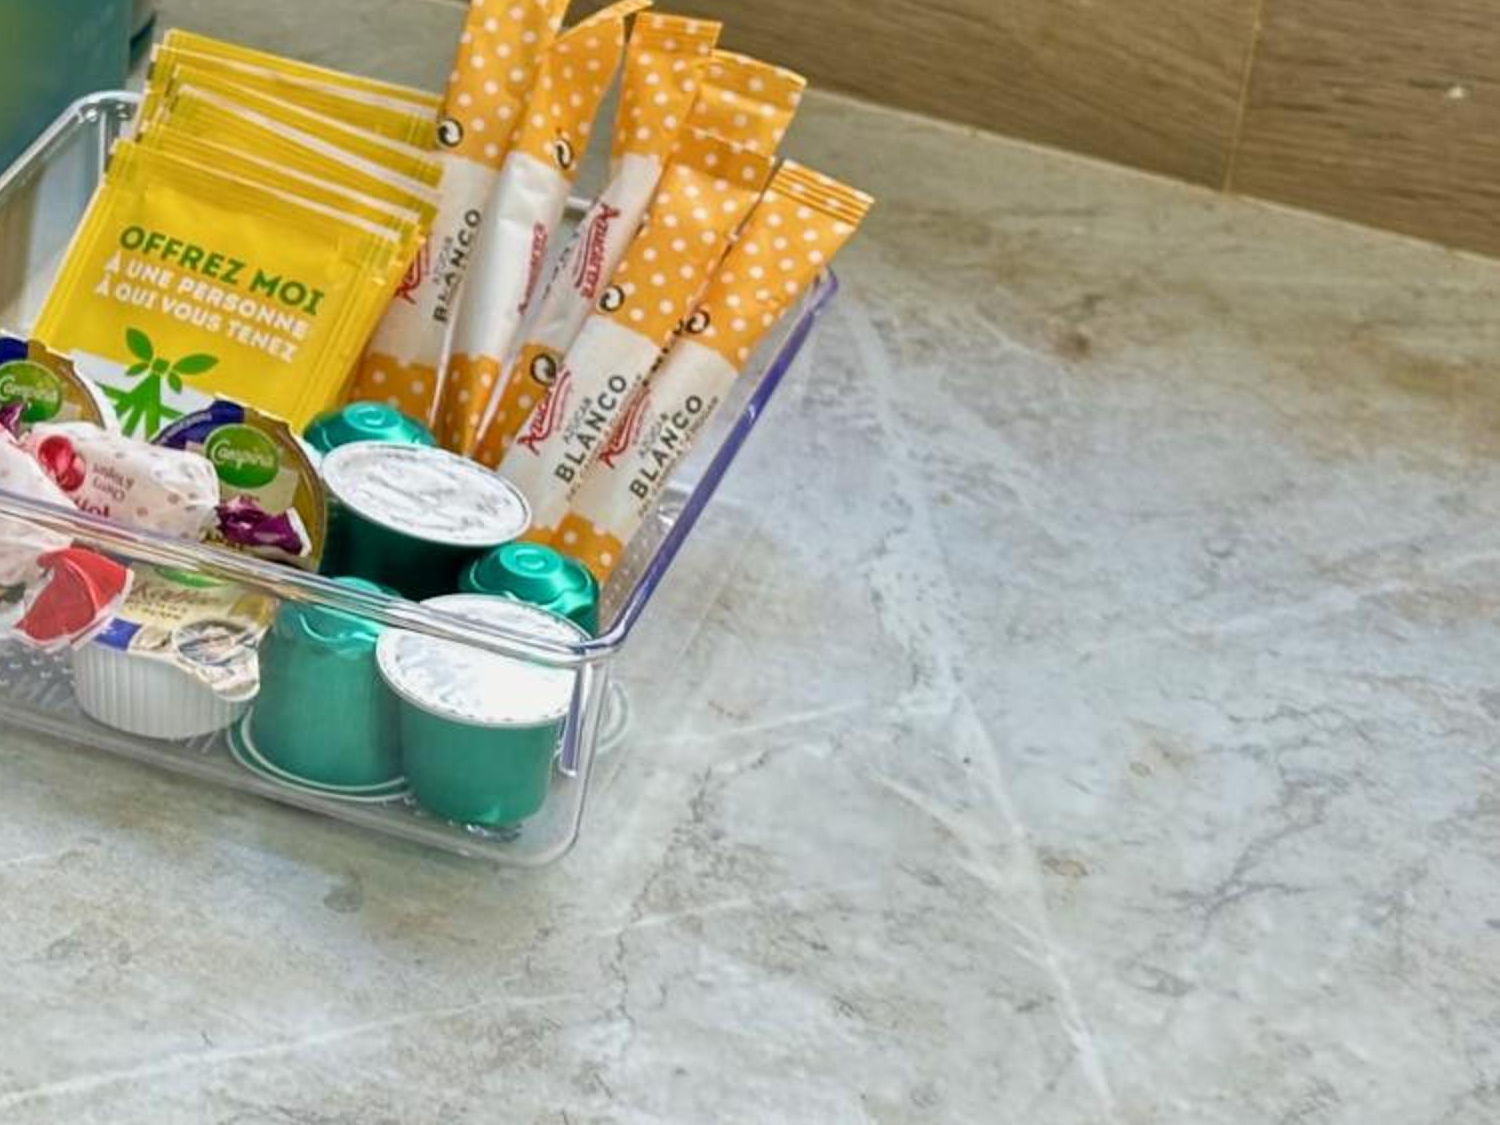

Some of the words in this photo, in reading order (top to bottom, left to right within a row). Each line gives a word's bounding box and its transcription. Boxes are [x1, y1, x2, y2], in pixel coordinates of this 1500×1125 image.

[119, 225, 246, 285] OFFREZ
[249, 268, 325, 316] MOI
[127, 258, 175, 288] UNE
[178, 277, 308, 341] PERSONNE
[433, 207, 482, 325] BLANCO
[115, 283, 158, 309] QUI
[161, 297, 222, 332] VOUS
[228, 319, 298, 364] TENEZ
[554, 374, 628, 485] BLANCO
[628, 394, 704, 501] BLANCO
